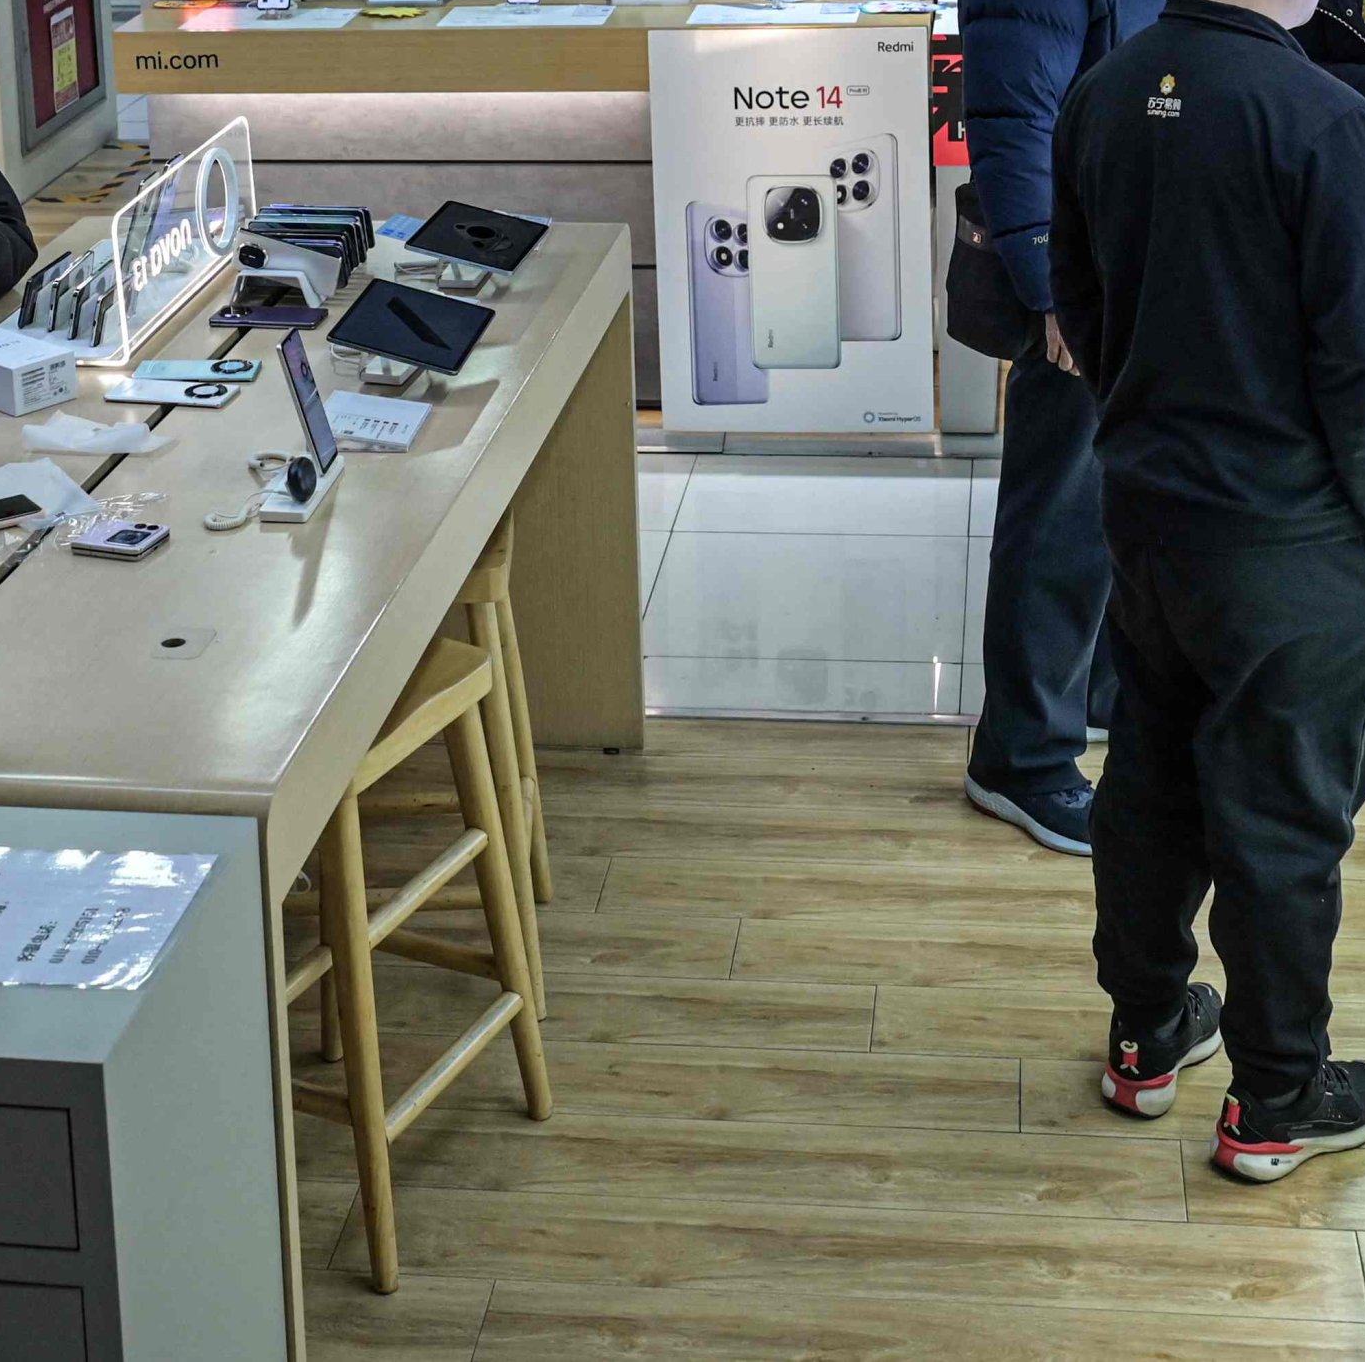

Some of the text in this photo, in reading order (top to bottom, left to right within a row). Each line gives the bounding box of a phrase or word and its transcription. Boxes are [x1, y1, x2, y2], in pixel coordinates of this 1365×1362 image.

[877, 40, 915, 53] Redmi
[135, 51, 220, 72] mi.com
[733, 85, 844, 110] Note 14
[1147, 97, 1182, 110] 苏宁易购
[734, 115, 845, 128] 更抗摔 更防水 更长续航
